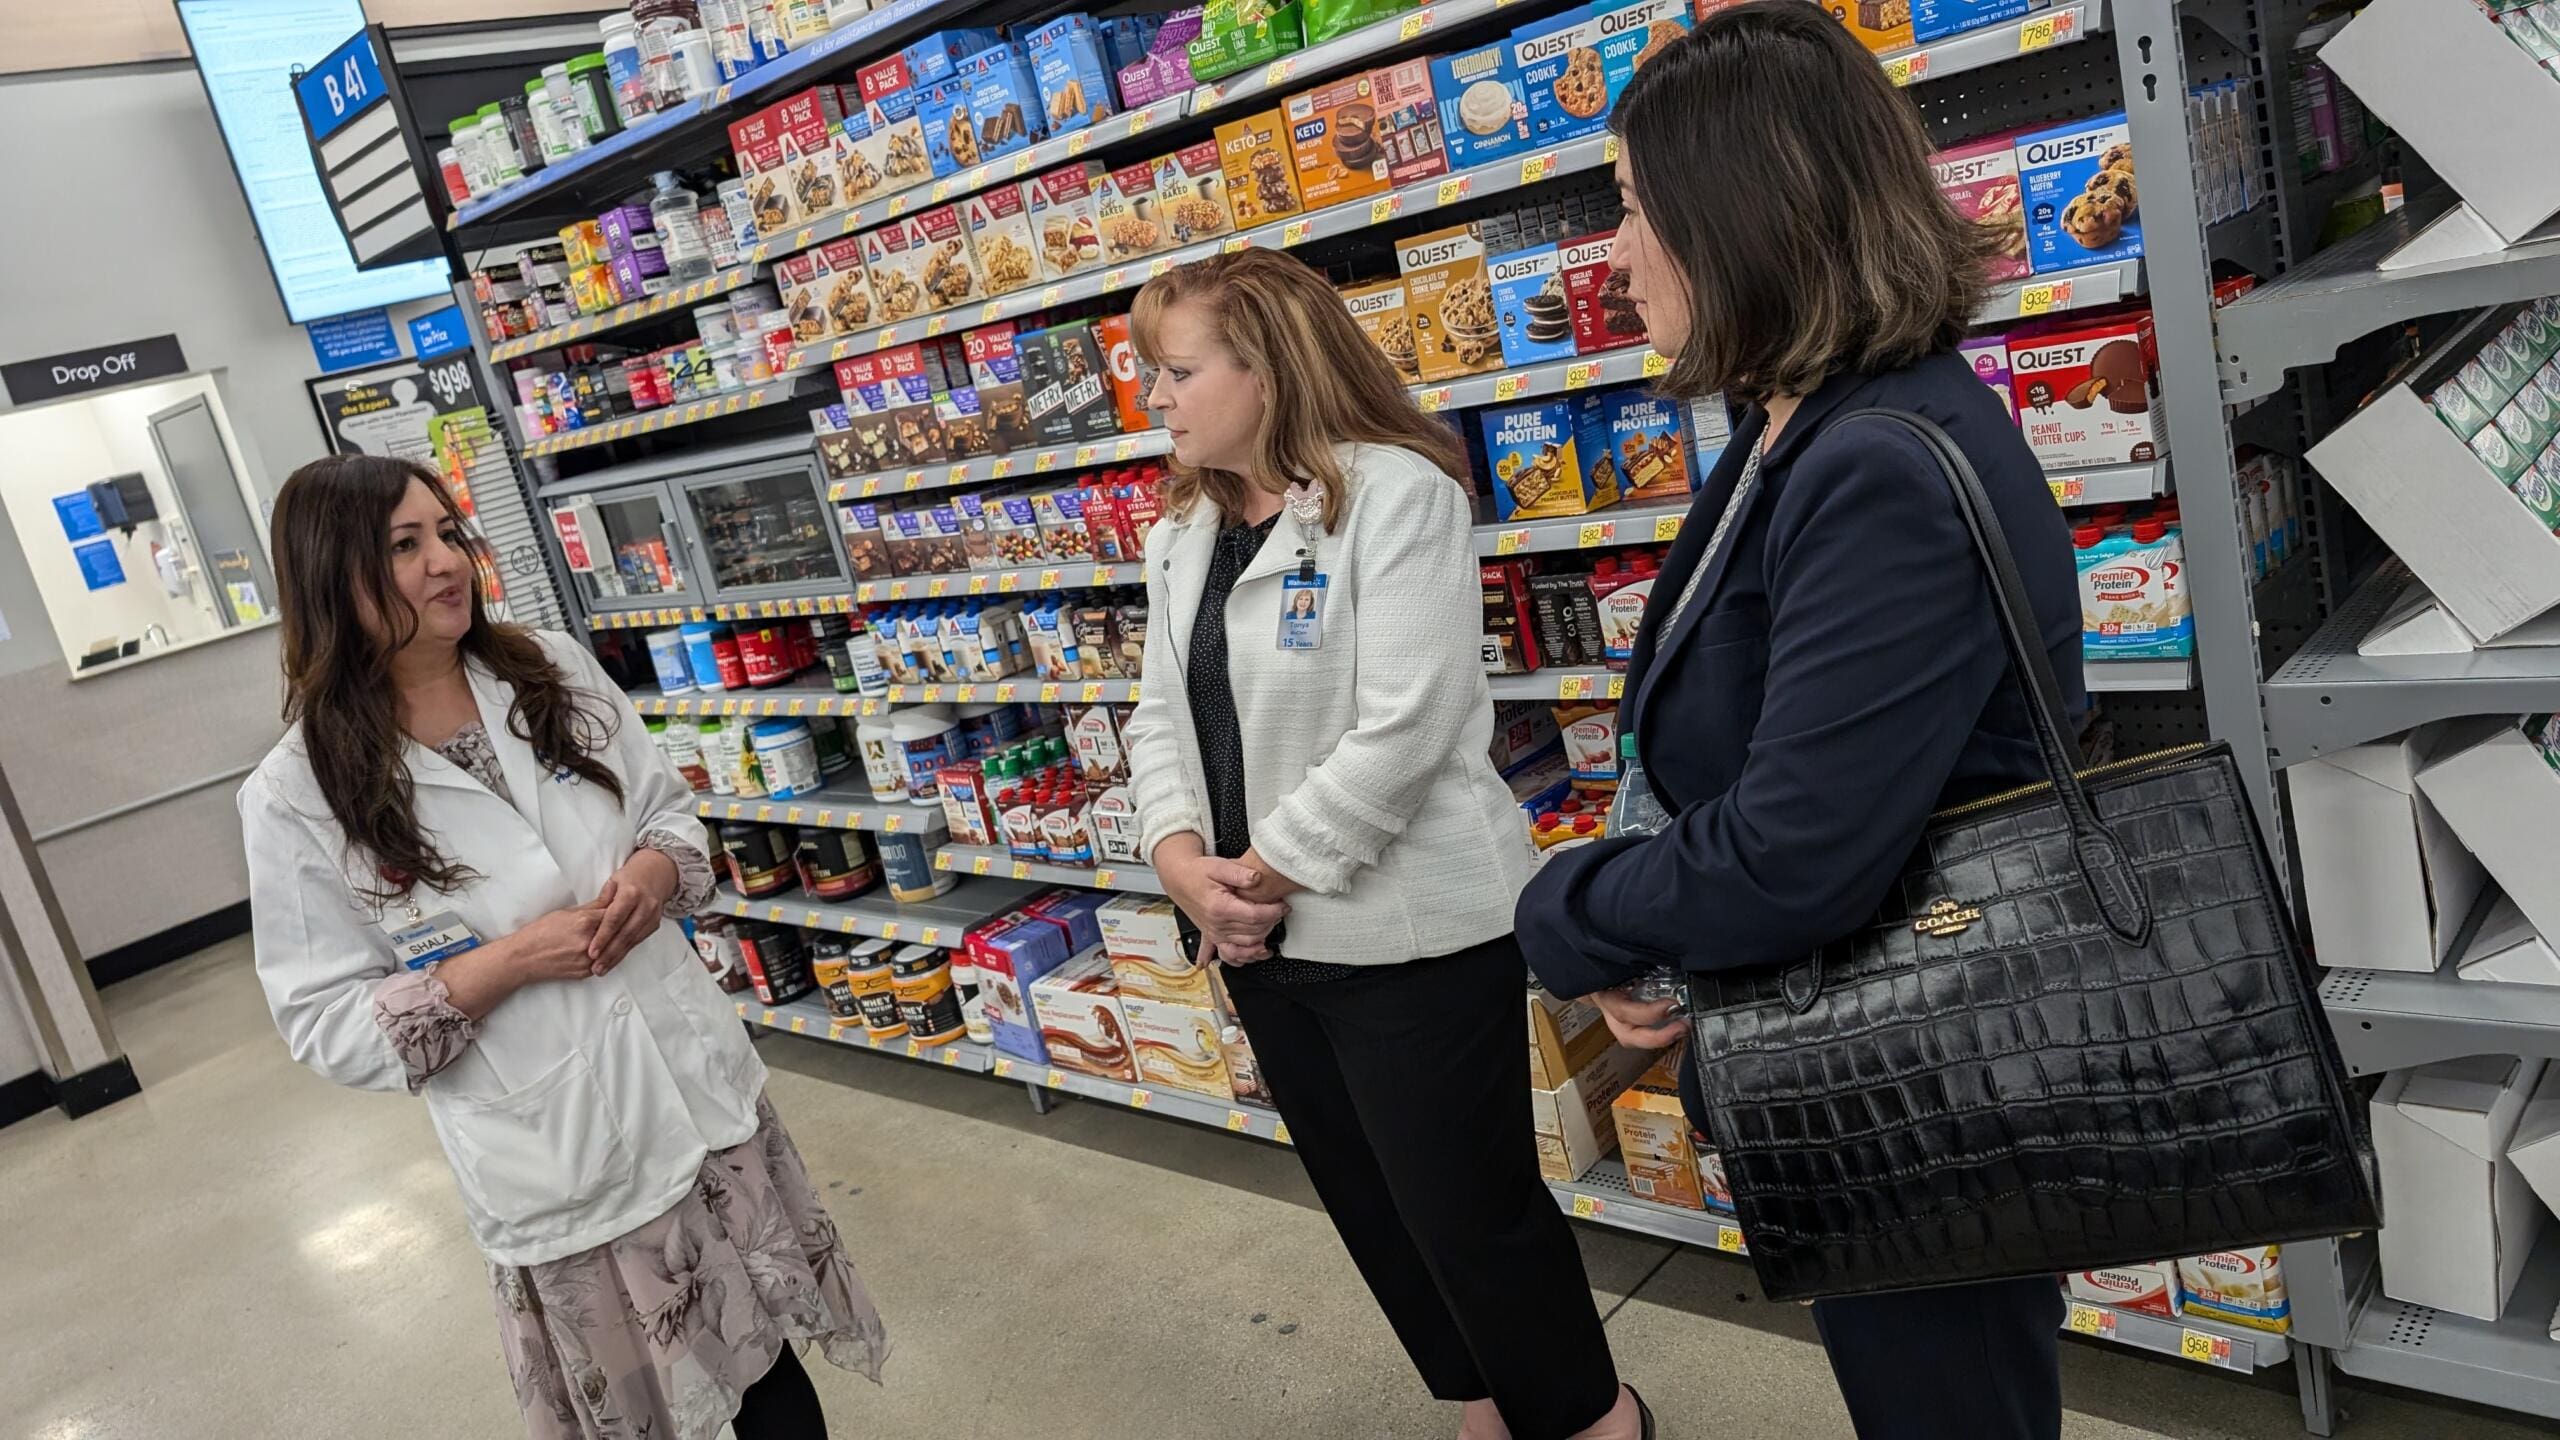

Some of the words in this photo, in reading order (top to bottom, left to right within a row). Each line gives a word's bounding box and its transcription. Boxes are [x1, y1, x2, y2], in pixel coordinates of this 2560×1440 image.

[1600, 5, 1655, 35] QUEST
[809, 45, 822, 58] Ask
[823, 39, 834, 51] for
[833, 22, 873, 48] assistance
[873, 13, 894, 29] with
[894, 3, 916, 21] items
[1230, 27, 1246, 40] CHILI
[1189, 37, 1221, 55] QUEST
[1233, 38, 1247, 50] LIME
[1522, 32, 1574, 59] QUEST
[1604, 37, 1638, 59] COOKIE
[865, 75, 874, 91] 8
[874, 65, 898, 81] VALUE
[1122, 68, 1150, 84] QUEST
[1526, 64, 1558, 85] COOKIE
[323, 73, 346, 117] B
[344, 53, 370, 104] 41
[879, 76, 899, 92] PACK
[1378, 94, 1396, 105] LEVEL
[781, 108, 789, 123] 8
[790, 97, 812, 114] VALUE
[794, 110, 812, 125] PACK
[739, 129, 747, 142] 8
[747, 119, 766, 132] VALUE
[750, 129, 767, 142] PACK
[1295, 122, 1325, 140] KETO
[1225, 135, 1257, 155] KETO
[1473, 133, 1512, 150] CINNAMON
[2027, 135, 2098, 165] QUEST
[1299, 153, 1318, 163] PEANUT
[1300, 160, 1318, 170] BUTTER
[1375, 162, 1385, 172] 14
[2029, 170, 2062, 184] BLUEBERRY
[1163, 178, 1180, 191] Soft
[2030, 181, 2053, 193] MUFFIN
[1162, 185, 1188, 199] BAKED
[1100, 206, 1125, 218] BAKED
[2037, 208, 2051, 216] 20g
[2042, 224, 2051, 232] 4g
[1406, 243, 1457, 268] QUEST
[1495, 259, 1540, 280] QUEST
[1569, 269, 1593, 281] CHOCOLATE
[1410, 273, 1437, 287] CHOCOLATE
[1437, 270, 1449, 281] CHIP
[1412, 284, 1430, 296] COOKIE
[1430, 280, 1447, 292] DOUGH
[1350, 294, 1388, 313] QUEST
[430, 330, 448, 344] Price
[967, 338, 986, 355] 20
[992, 340, 1014, 353] PACK
[881, 358, 892, 371] 10
[892, 351, 915, 364] VALUE
[1977, 357, 1993, 367] <1g
[2017, 347, 2085, 371] QUEST
[51, 361, 101, 385] Drop
[102, 352, 137, 375] Off
[841, 368, 852, 382] 10
[851, 362, 873, 374] VALUE
[897, 362, 916, 373] PACK
[1980, 364, 1995, 374] sugar
[856, 371, 874, 383] PACK
[366, 388, 378, 398] to
[2030, 385, 2046, 395] <1g
[2032, 393, 2049, 403] sugar
[341, 404, 359, 417] the
[359, 398, 390, 412] Expert
[1555, 404, 1564, 412] 12
[1621, 401, 1657, 419] PURE
[1504, 411, 1542, 430] PURE
[1613, 412, 1670, 433] PROTEIN
[2125, 419, 2135, 428] 1g
[1496, 424, 1557, 446] PROTEIN
[2031, 423, 2062, 436] PEANUT
[2033, 434, 2063, 446] BUTTER
[2064, 431, 2087, 443] CUPS
[1499, 465, 1511, 473] 20g
[1086, 503, 1113, 514] STRONG
[1127, 500, 1156, 512] STRONG
[1482, 571, 1502, 580] PACK
[2090, 569, 2135, 583] Premier
[1531, 582, 1549, 590] Fueled
[1549, 582, 1558, 590] by
[2093, 580, 2134, 591] Protein
[1607, 596, 1639, 606] Premier
[1610, 604, 1638, 613] Protein
[2101, 624, 2119, 632] 30g
[1282, 638, 1293, 648] 15
[1615, 638, 1628, 647] 30g
[1571, 726, 1600, 734] Premier
[1573, 732, 1599, 740] Protein
[1915, 908, 1981, 931] COACH
[408, 933, 454, 956] SHALA
[1119, 937, 1158, 947] Replacement
[861, 995, 891, 1008] WHEY
[865, 1003, 893, 1013] PROTEIN
[900, 1005, 923, 1016] WHEY
[1051, 1010, 1086, 1021] Replacement
[1143, 1022, 1180, 1035] Replacement
[1586, 1080, 1620, 1113] Protein
[1624, 1128, 1657, 1141] Protein
[2198, 1257, 2238, 1273] Protein
[2099, 1270, 2139, 1285] Protein
[2098, 1276, 2144, 1295] Premier
